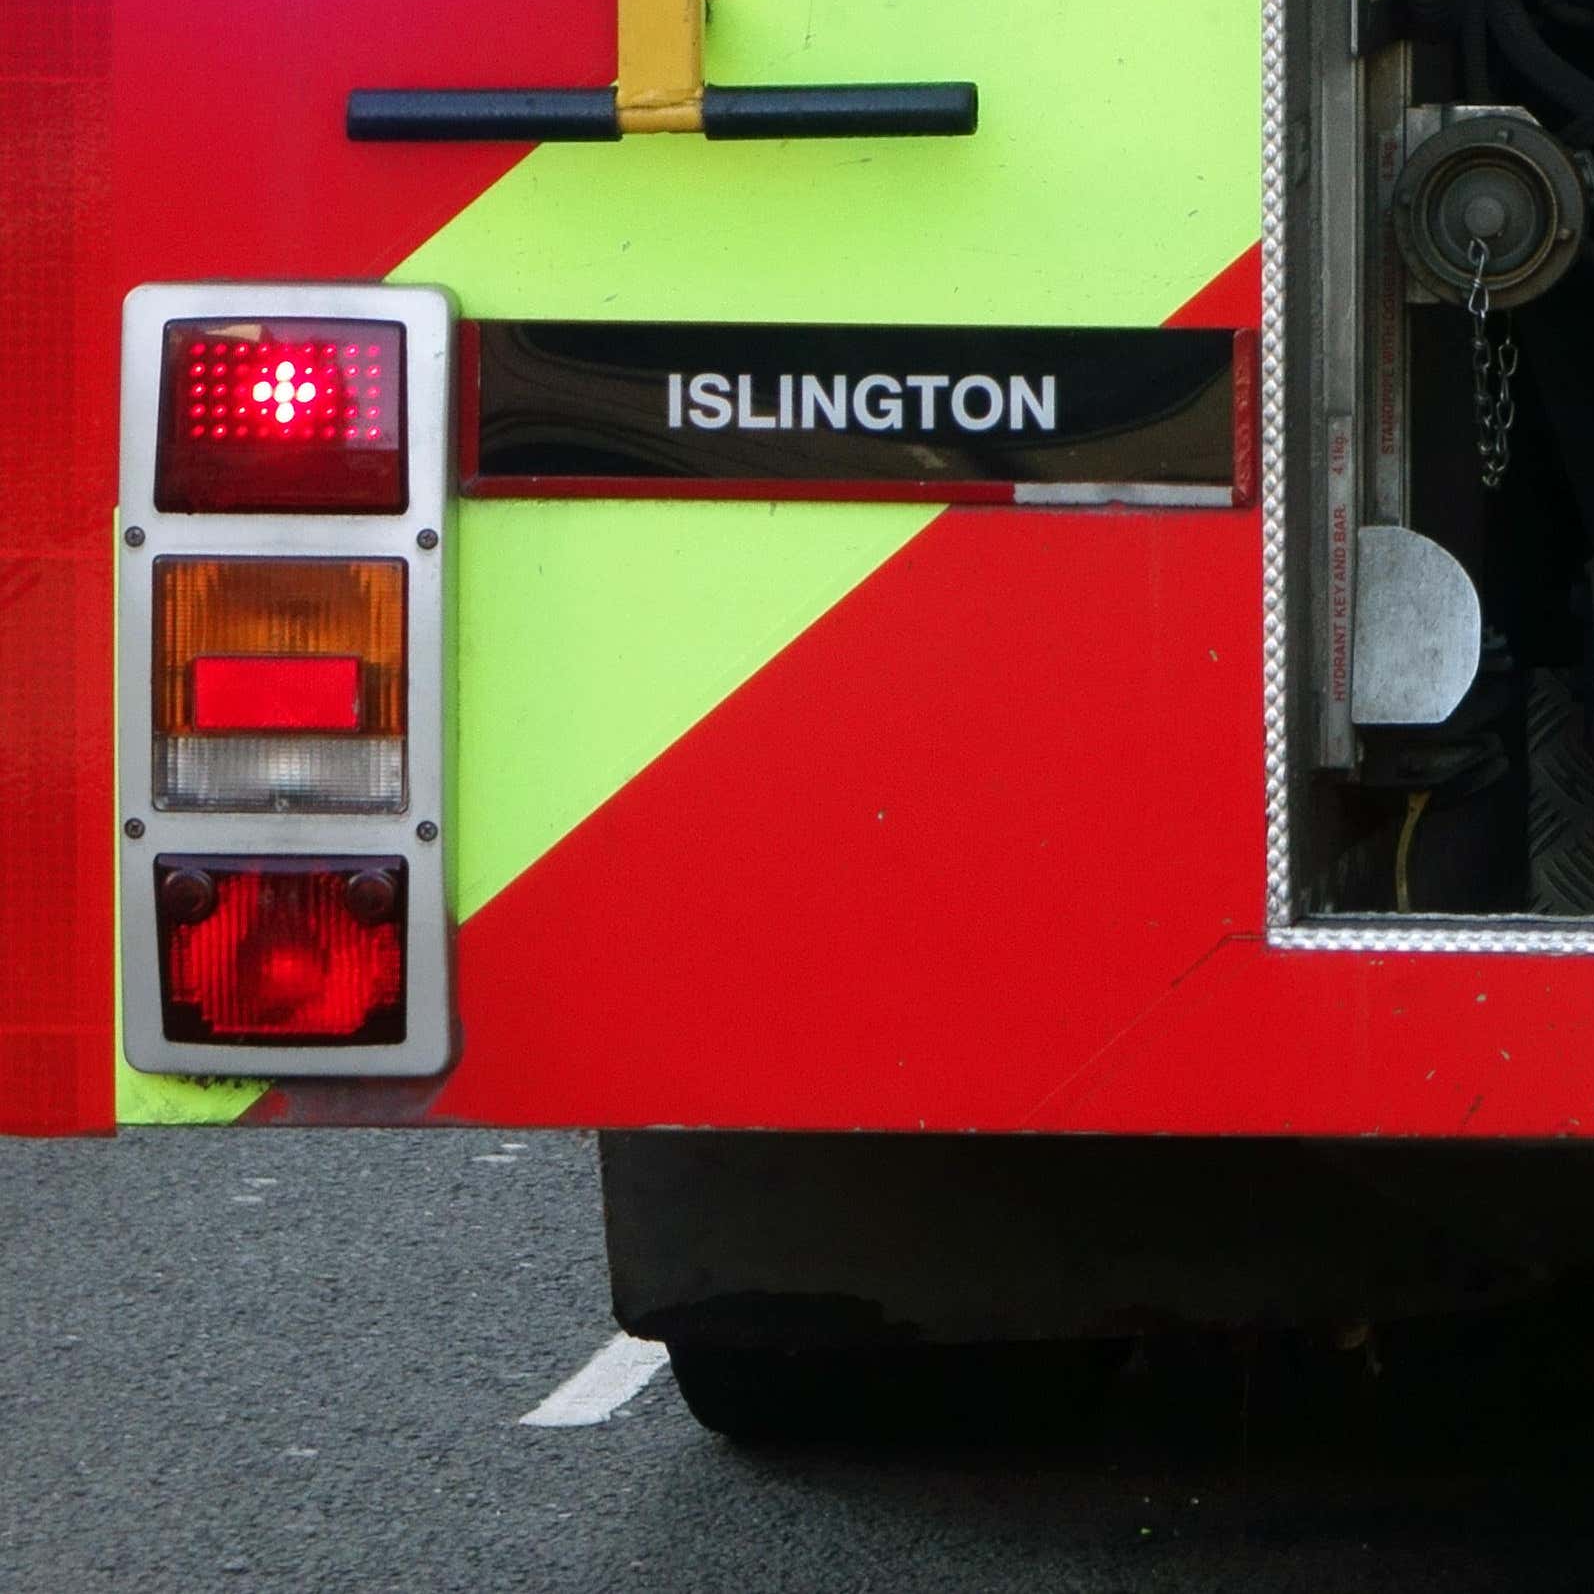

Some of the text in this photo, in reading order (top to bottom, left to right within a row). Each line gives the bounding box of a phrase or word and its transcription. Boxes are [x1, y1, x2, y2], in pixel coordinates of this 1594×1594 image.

[667, 372, 1057, 432] ISLINGTON
[1333, 547, 1347, 582] AND
[1332, 587, 1347, 619] KEY
[1332, 623, 1346, 702] HYDRANT
